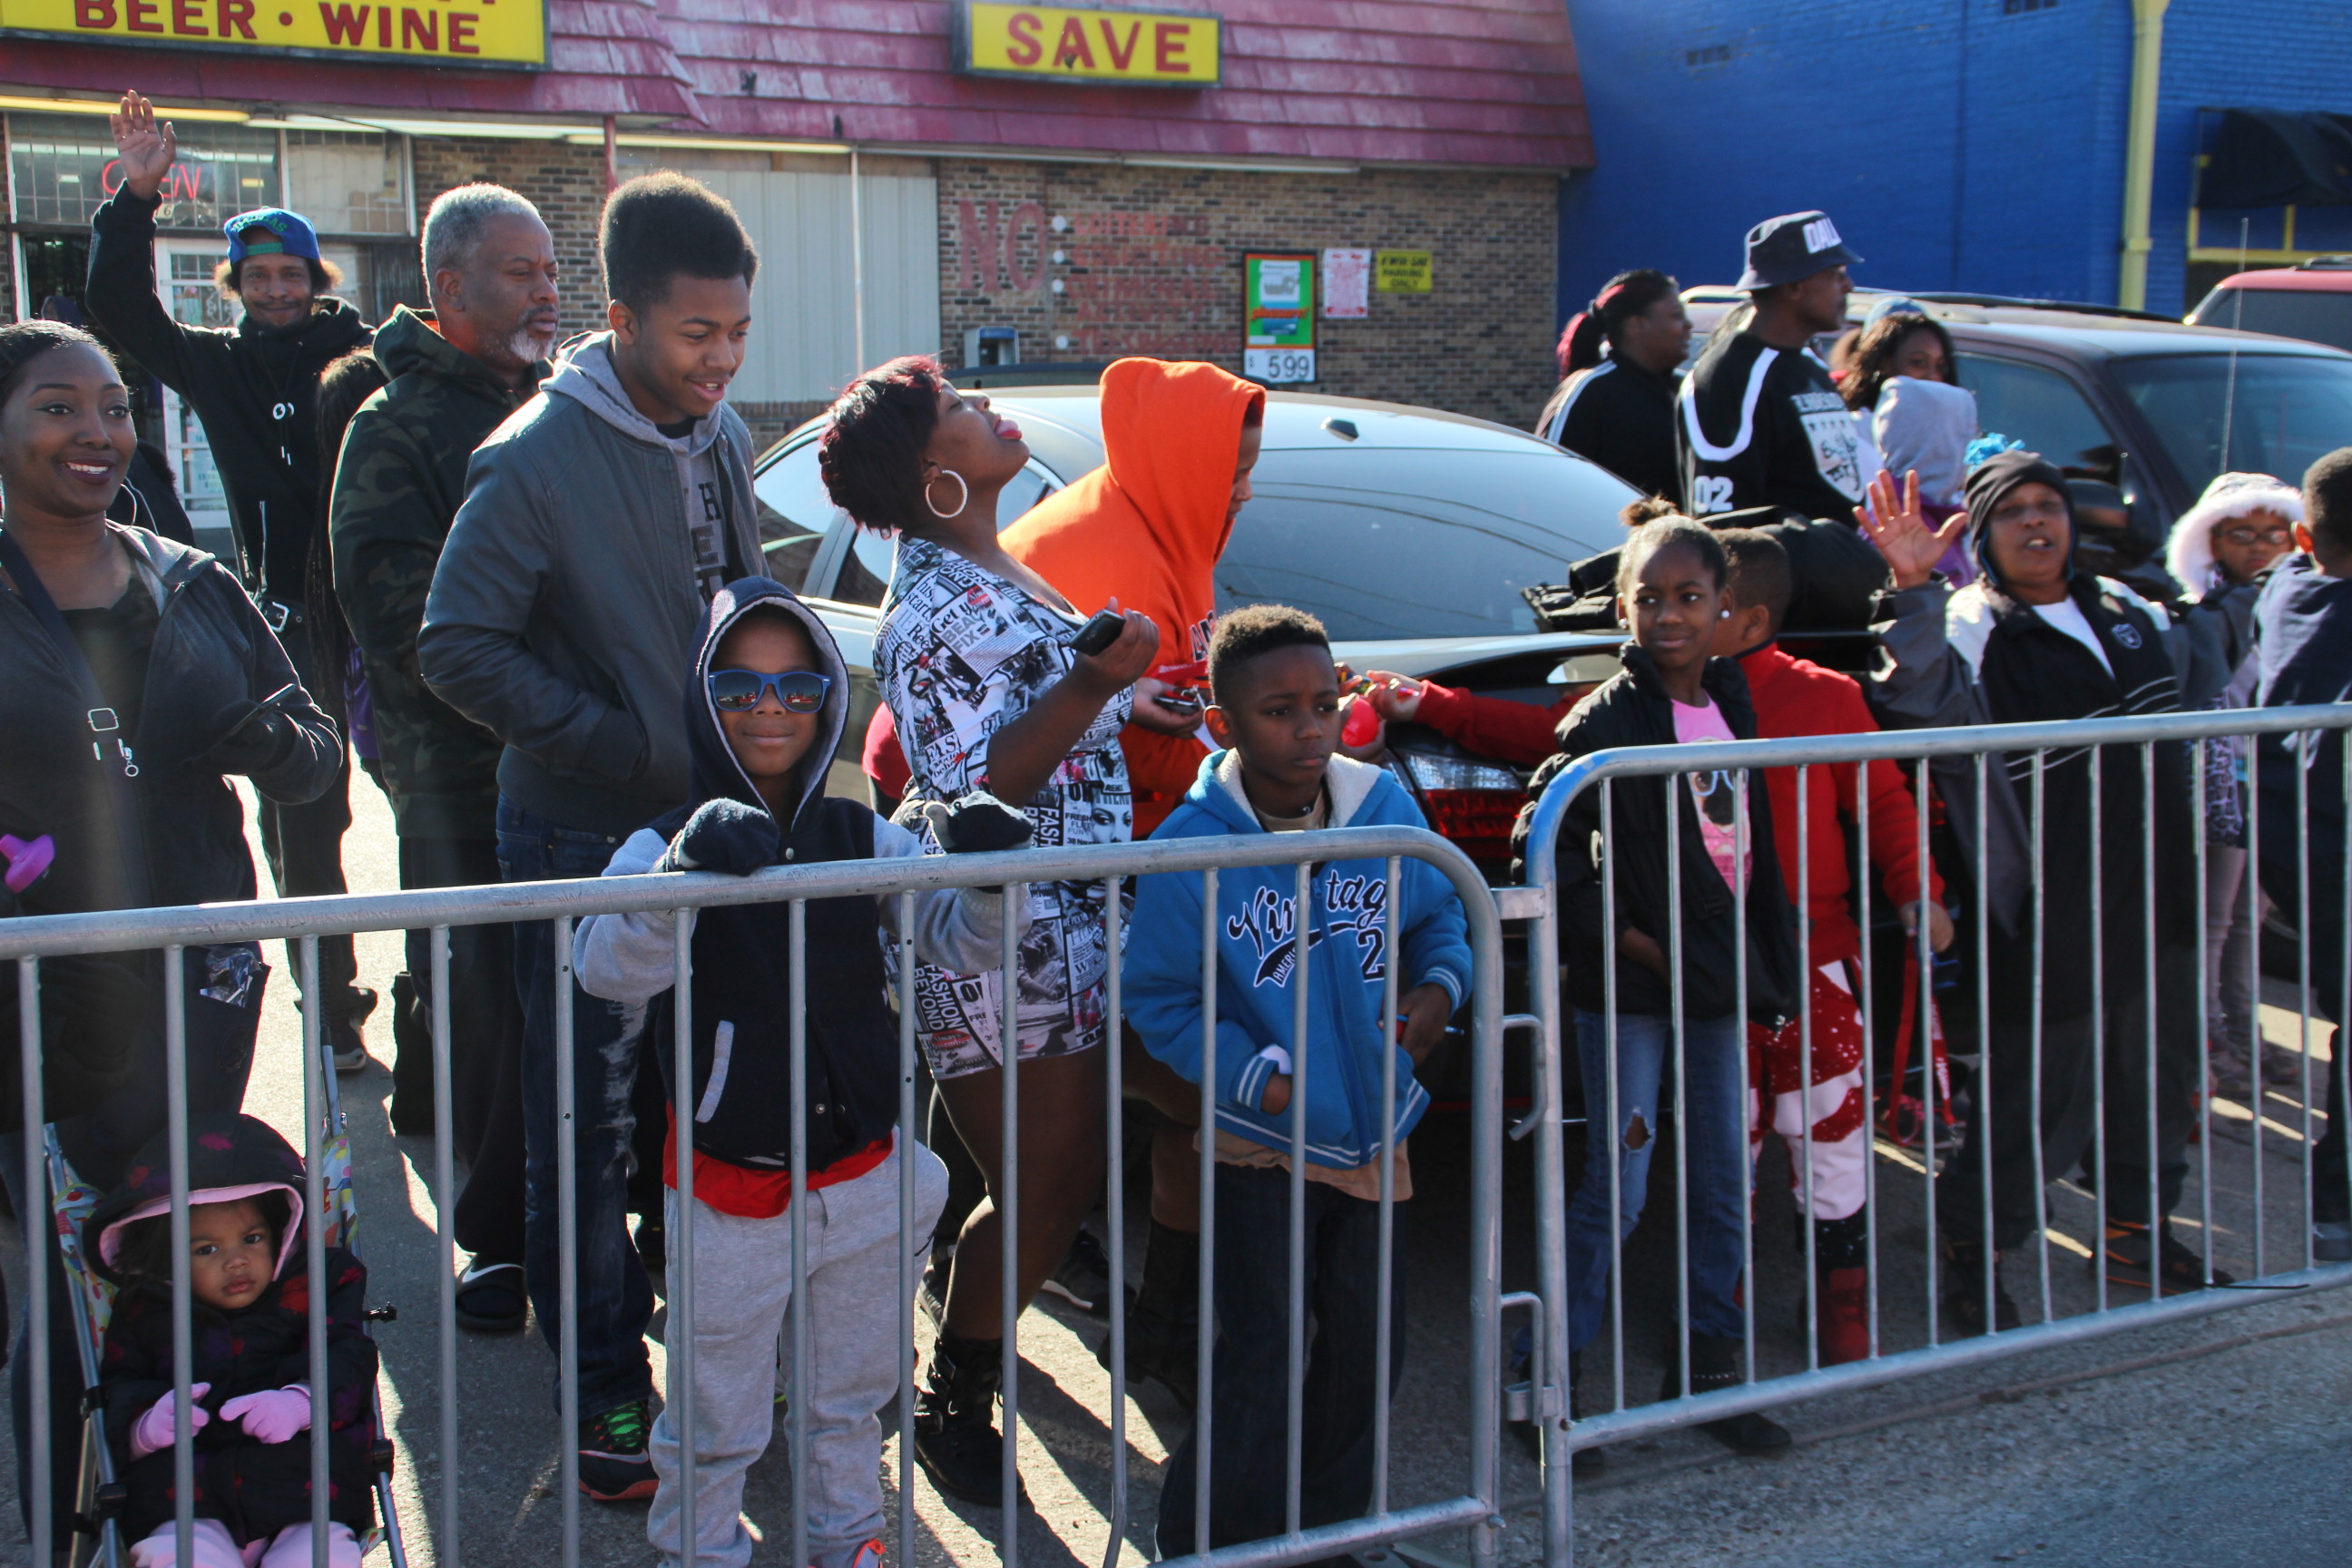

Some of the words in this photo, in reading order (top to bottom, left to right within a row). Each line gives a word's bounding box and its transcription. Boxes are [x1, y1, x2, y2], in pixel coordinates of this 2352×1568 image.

[75, 0, 257, 39] BEER
[321, 2, 480, 54] WINE
[1006, 12, 1191, 73] SAVE
[103, 159, 201, 199] OEN
[956, 199, 1047, 291] NO
[1693, 475, 1734, 514] 02
[931, 609, 959, 634] Get
[953, 628, 980, 655] FIX
[915, 967, 946, 1031] BEYOND
[924, 965, 966, 1030] FASHION
